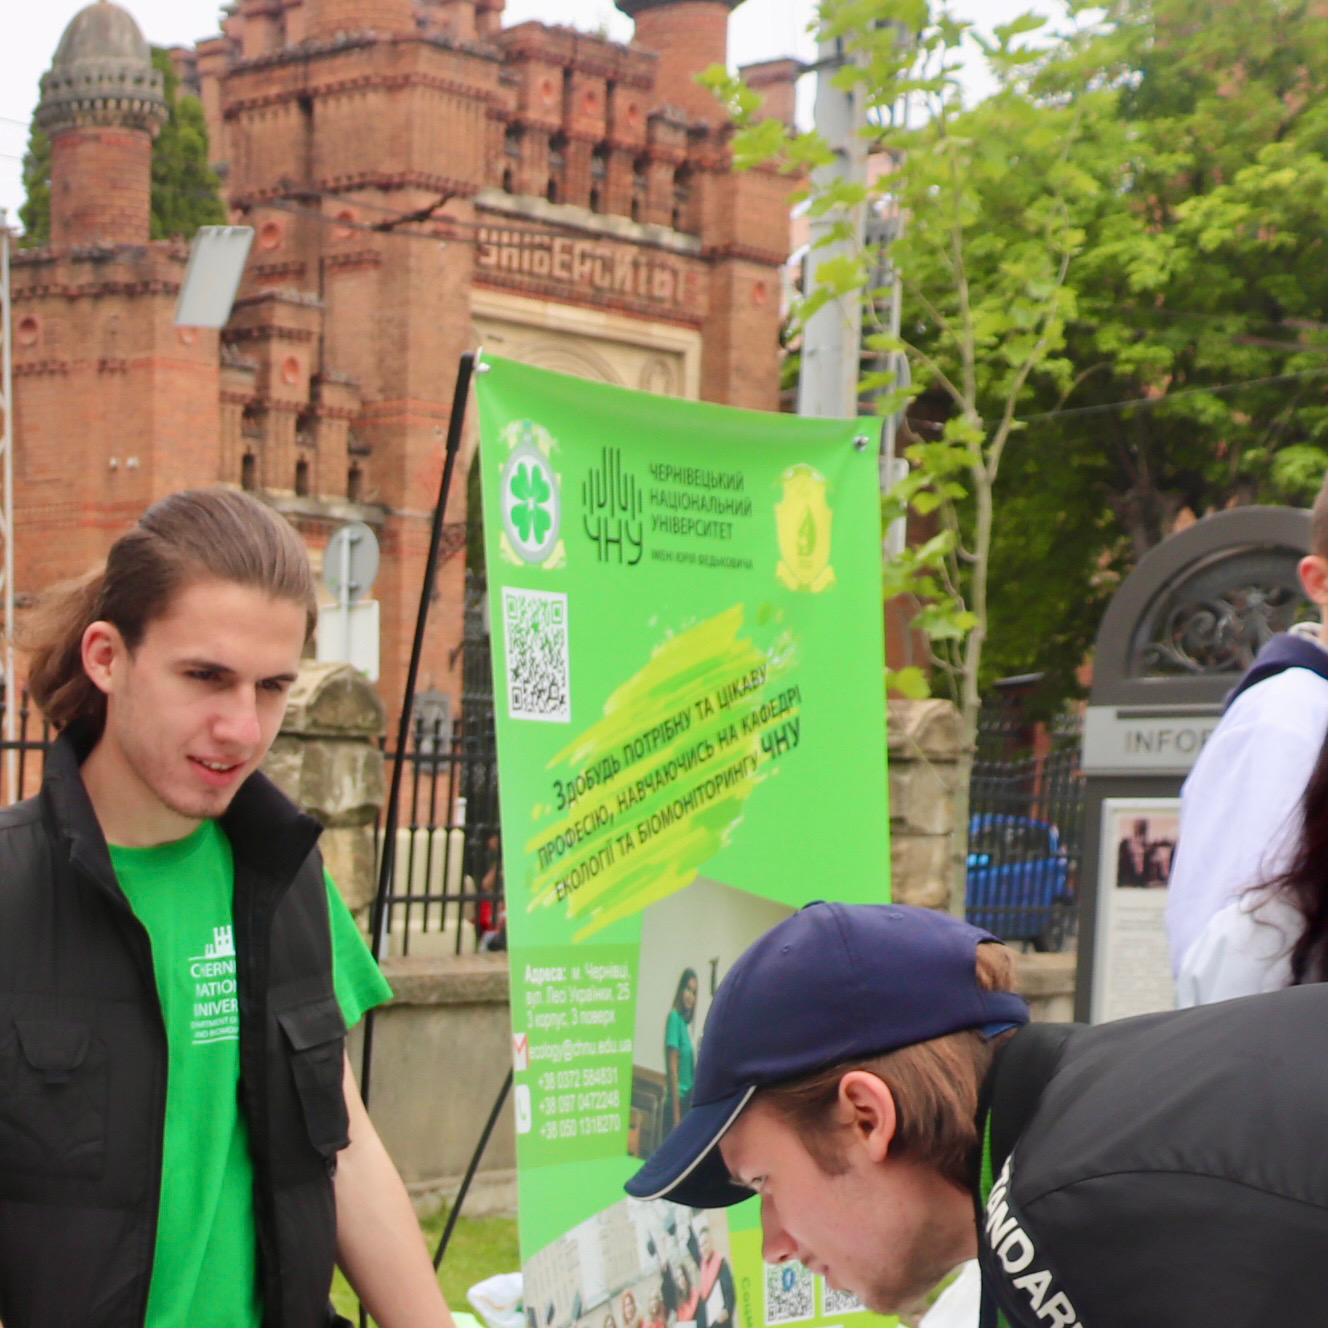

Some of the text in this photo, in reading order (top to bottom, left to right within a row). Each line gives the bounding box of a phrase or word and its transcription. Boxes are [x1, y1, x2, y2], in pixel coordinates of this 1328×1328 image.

[650, 462, 744, 491] ЧЕРНІВЕЦЬКИЙ
[650, 488, 752, 516] НАЦІОНАЛЬНИЙ
[651, 514, 733, 539] УНІВЕРСИТЕТ
[623, 708, 692, 764] ПОТРІБНУ
[695, 697, 714, 721] ТА
[716, 665, 767, 710] ЦІКАВУ
[537, 685, 803, 870] ПРОФЕСІЮ, НАВЧАЮЧИСЬ НА КАФЕДРІ
[555, 716, 802, 902] ЕКОЛОГІЇ ТА БІОМОНІТОРИНГУ ЧНУ
[617, 982, 631, 1001] 25
